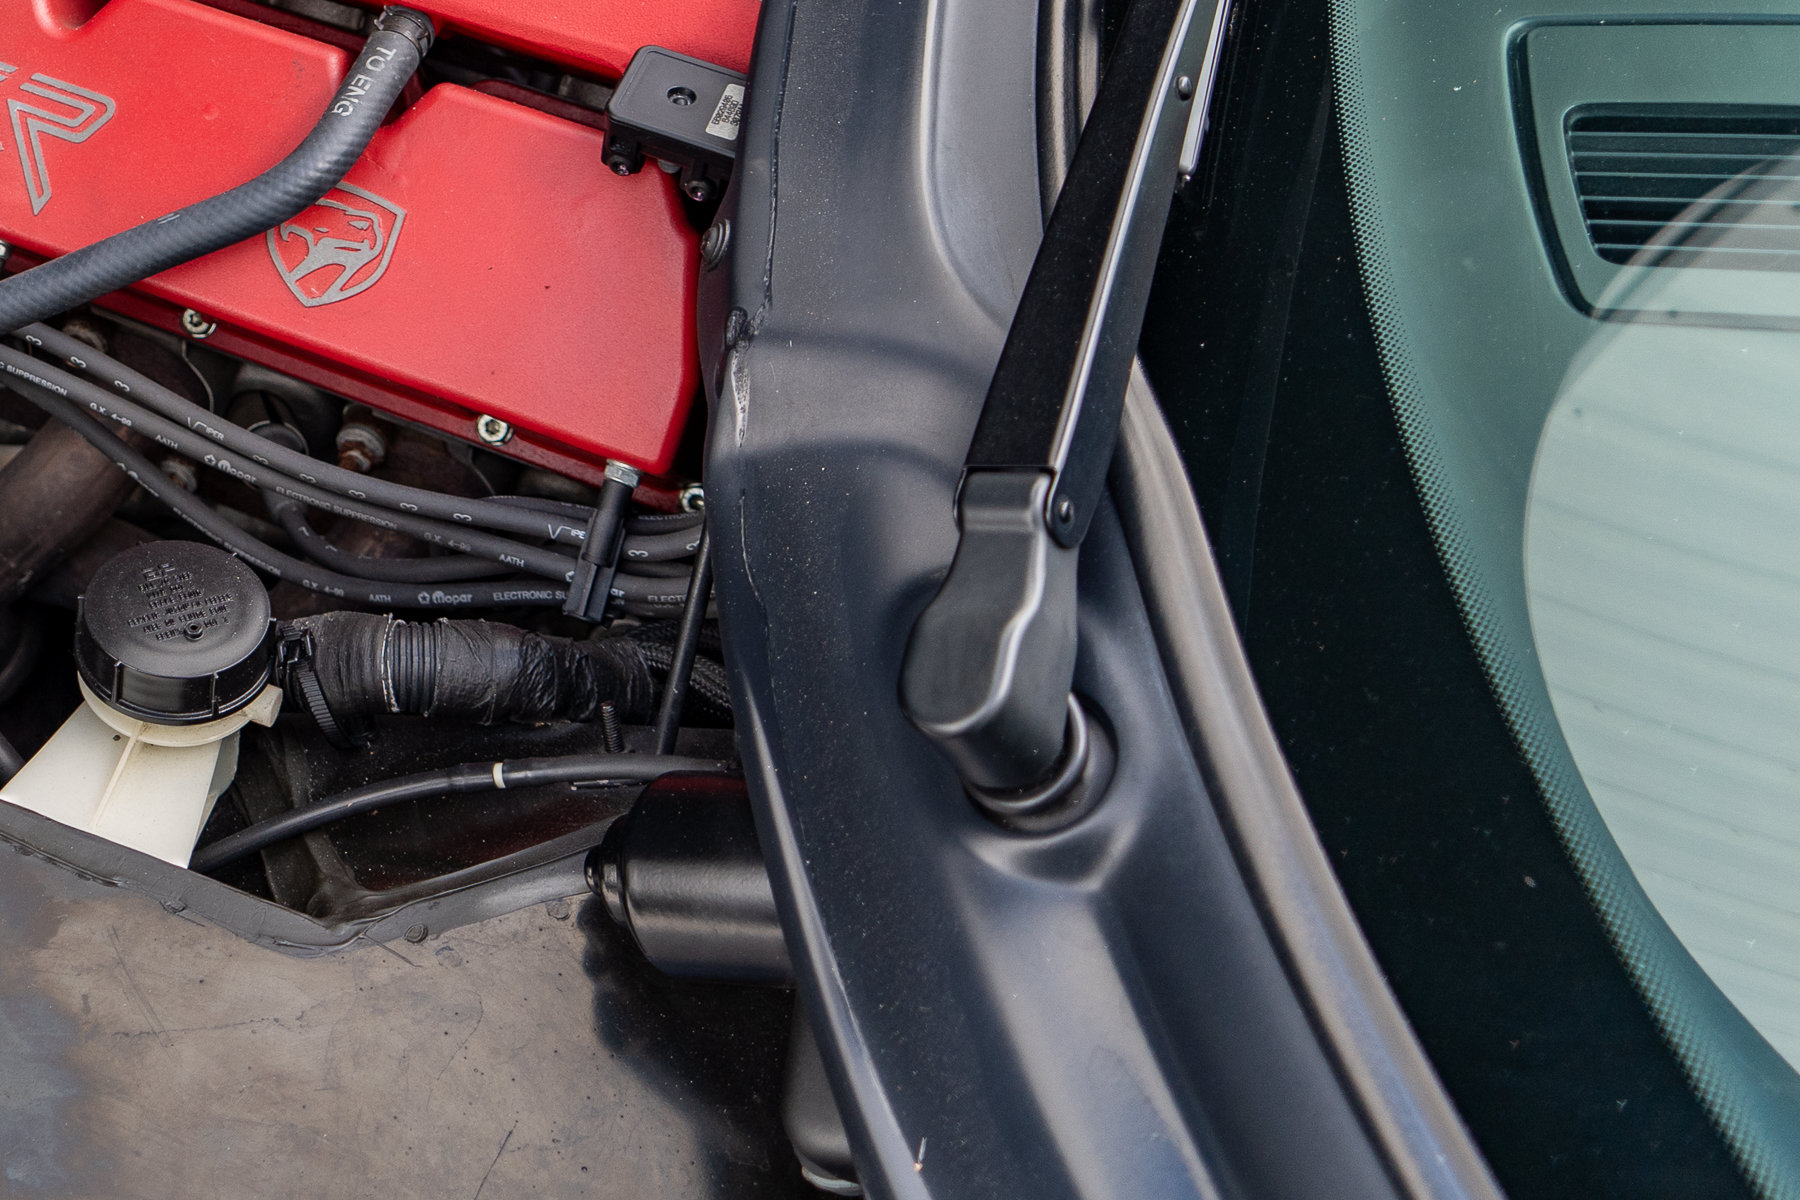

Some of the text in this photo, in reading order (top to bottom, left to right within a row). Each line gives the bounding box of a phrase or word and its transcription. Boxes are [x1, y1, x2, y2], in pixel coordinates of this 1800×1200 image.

[331, 46, 397, 117] TO ENG
[6, 365, 68, 397] SUPPRESSION
[333, 504, 398, 530] SUPPRESSION
[499, 553, 525, 568] AATH
[187, 416, 225, 441] VIPER
[548, 524, 586, 540] VIPE
[368, 593, 392, 604] AATH
[431, 590, 474, 606] Mopar
[492, 590, 554, 601] ELECTRONIC
